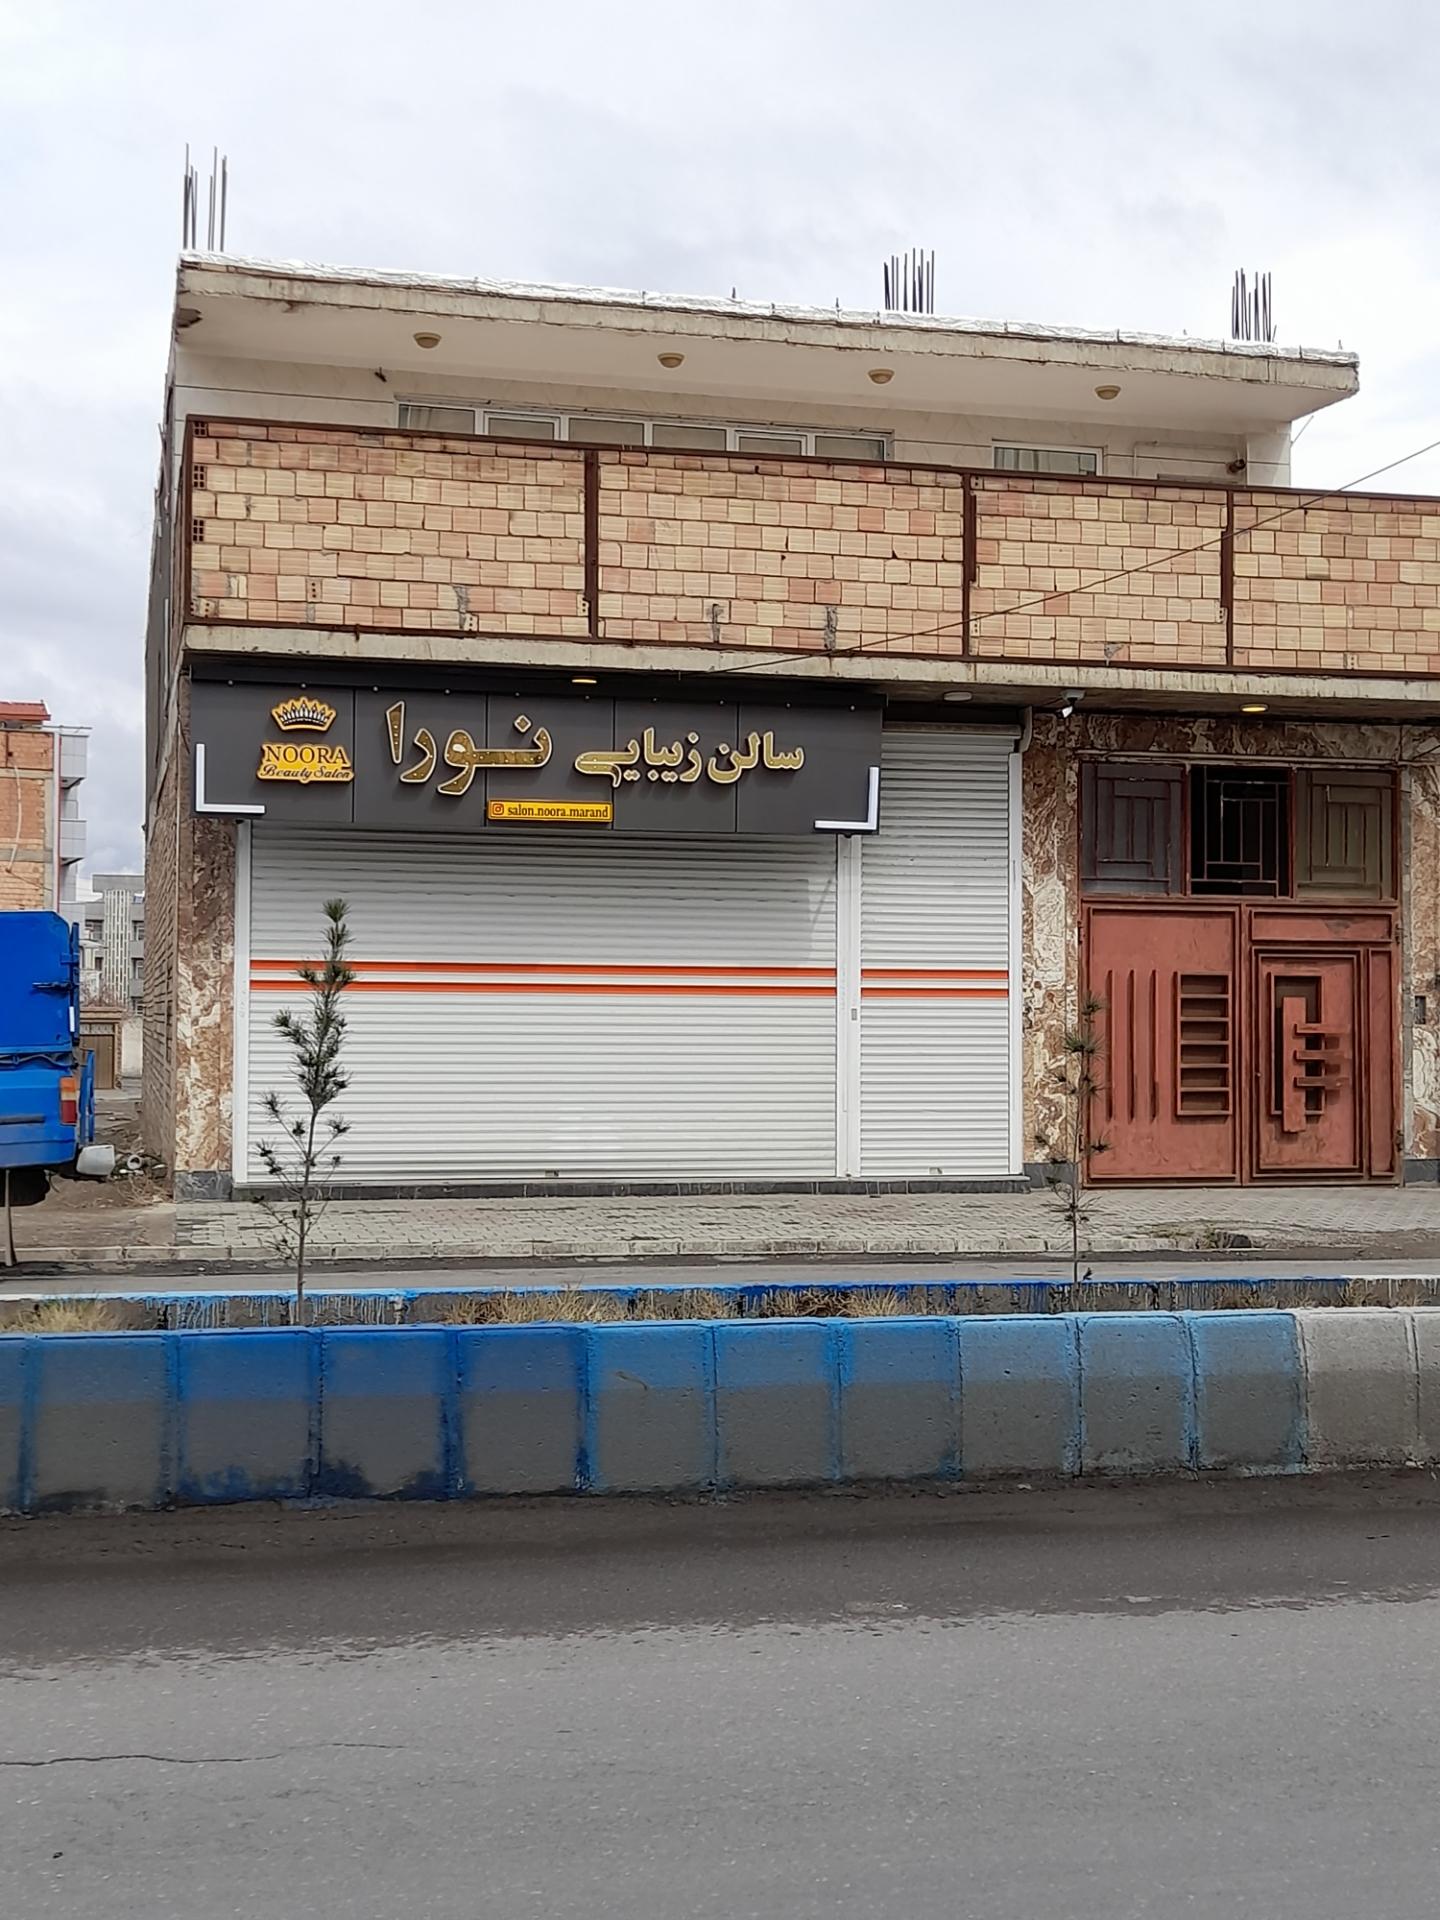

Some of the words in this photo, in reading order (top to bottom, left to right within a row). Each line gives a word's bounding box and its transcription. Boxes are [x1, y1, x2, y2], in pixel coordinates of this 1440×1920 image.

[264, 744, 348, 765] NOORA
[385, 700, 553, 796] نورا
[574, 726, 703, 788] زیبایی
[706, 731, 805, 784] سالن
[260, 763, 312, 780] Beauty
[313, 765, 351, 780] Salon
[507, 803, 609, 818] salon.noora.marand
